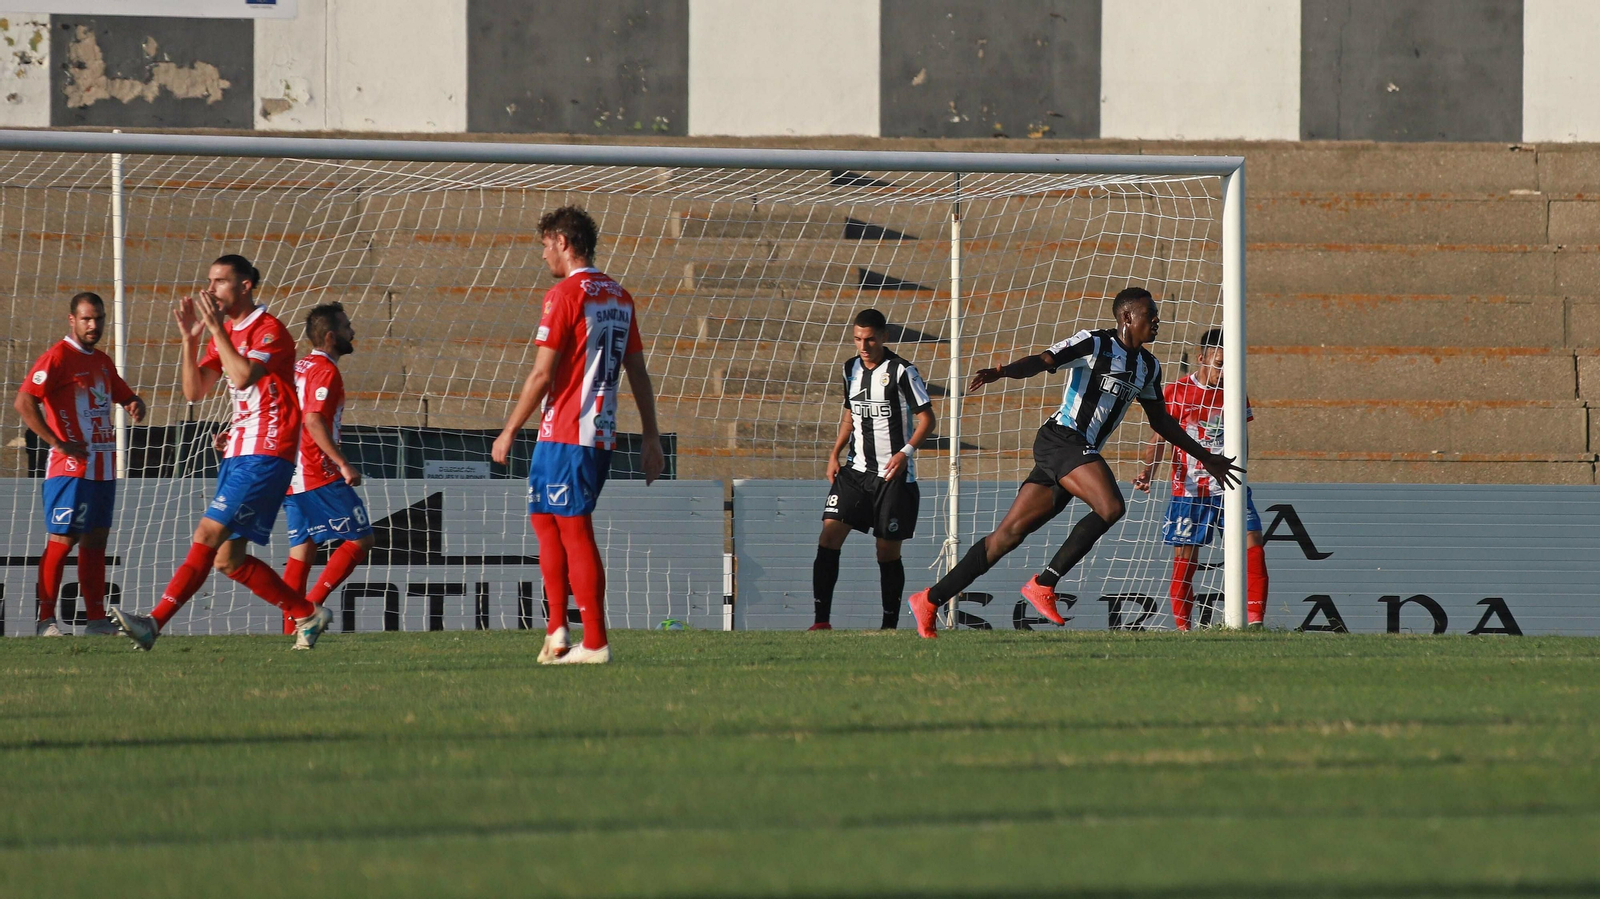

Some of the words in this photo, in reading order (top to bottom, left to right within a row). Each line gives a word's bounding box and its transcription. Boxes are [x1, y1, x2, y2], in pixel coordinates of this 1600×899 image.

[592, 325, 628, 392] 15
[1099, 376, 1138, 402] LOTU
[851, 402, 893, 420] OTUS
[826, 494, 839, 507] 18
[76, 502, 88, 524] 2
[353, 505, 367, 525] 8
[1175, 516, 1193, 537] 12
